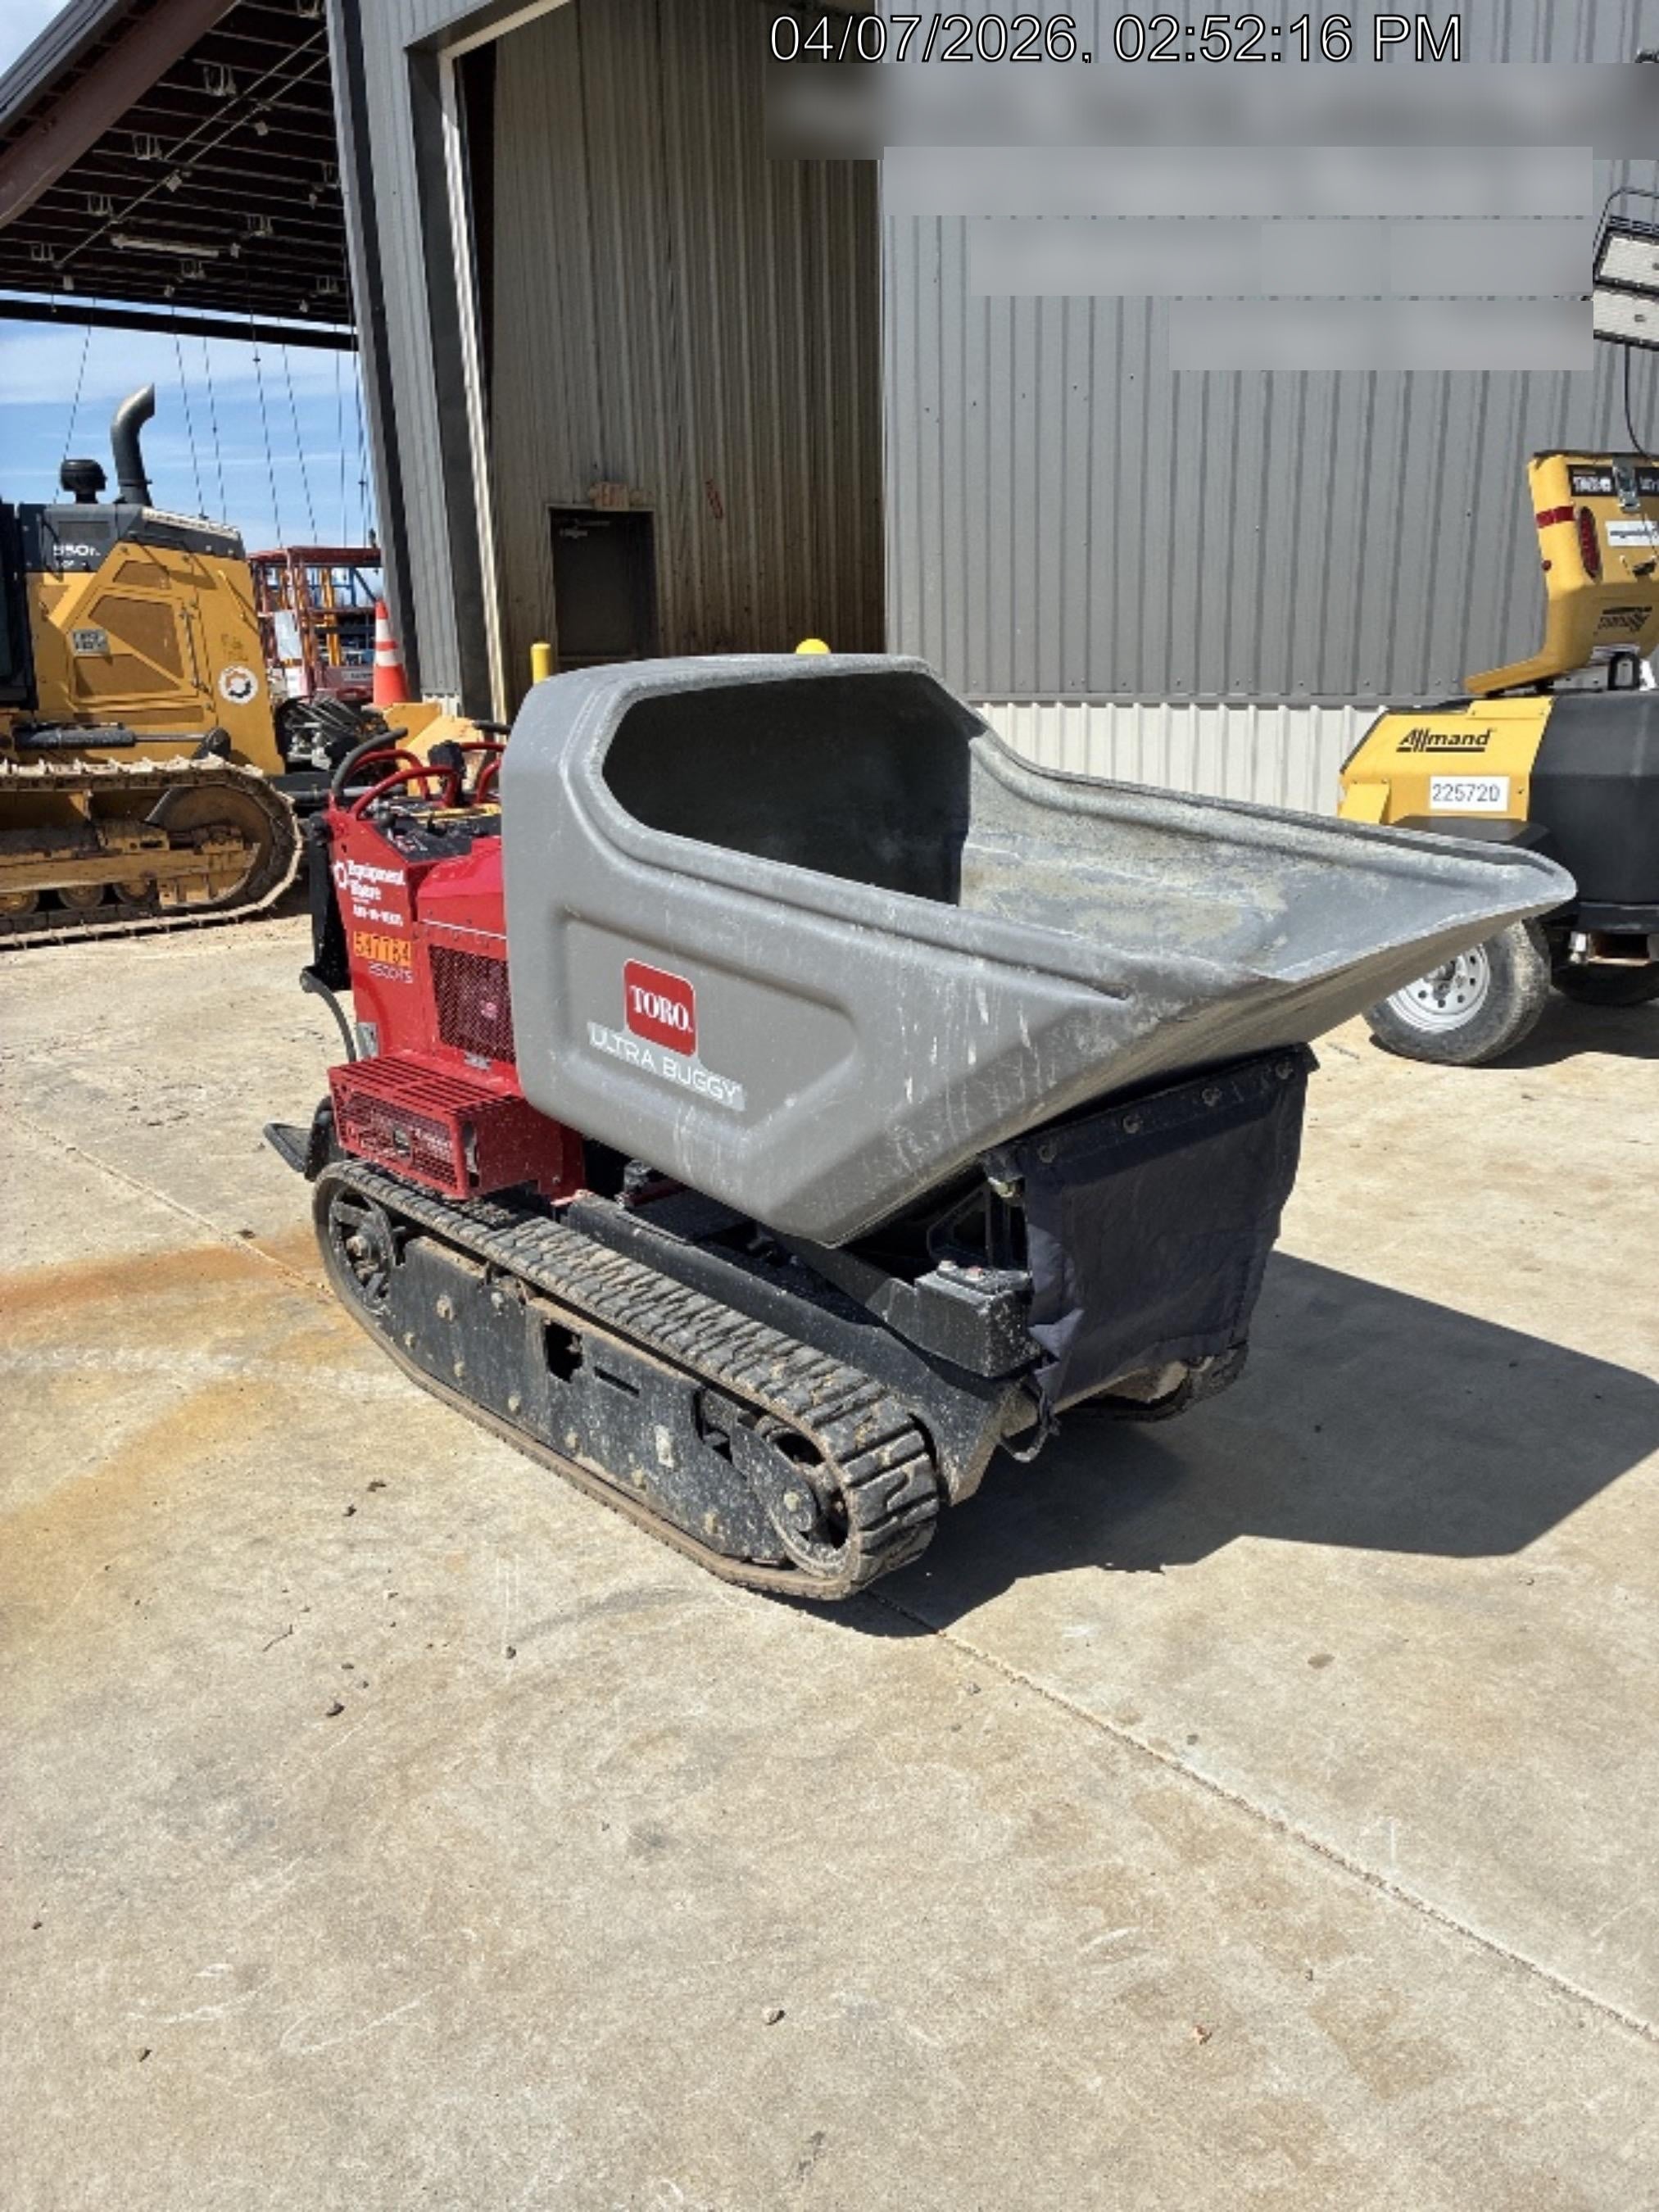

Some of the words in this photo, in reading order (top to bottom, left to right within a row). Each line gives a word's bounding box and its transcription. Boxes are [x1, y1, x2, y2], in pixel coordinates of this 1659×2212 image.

[1398, 728, 1491, 752] Allmand
[1432, 783, 1500, 802] 225720
[629, 985, 691, 1031] TORO
[591, 1026, 656, 1073] ULTRA
[662, 1055, 741, 1106] BUGGY
